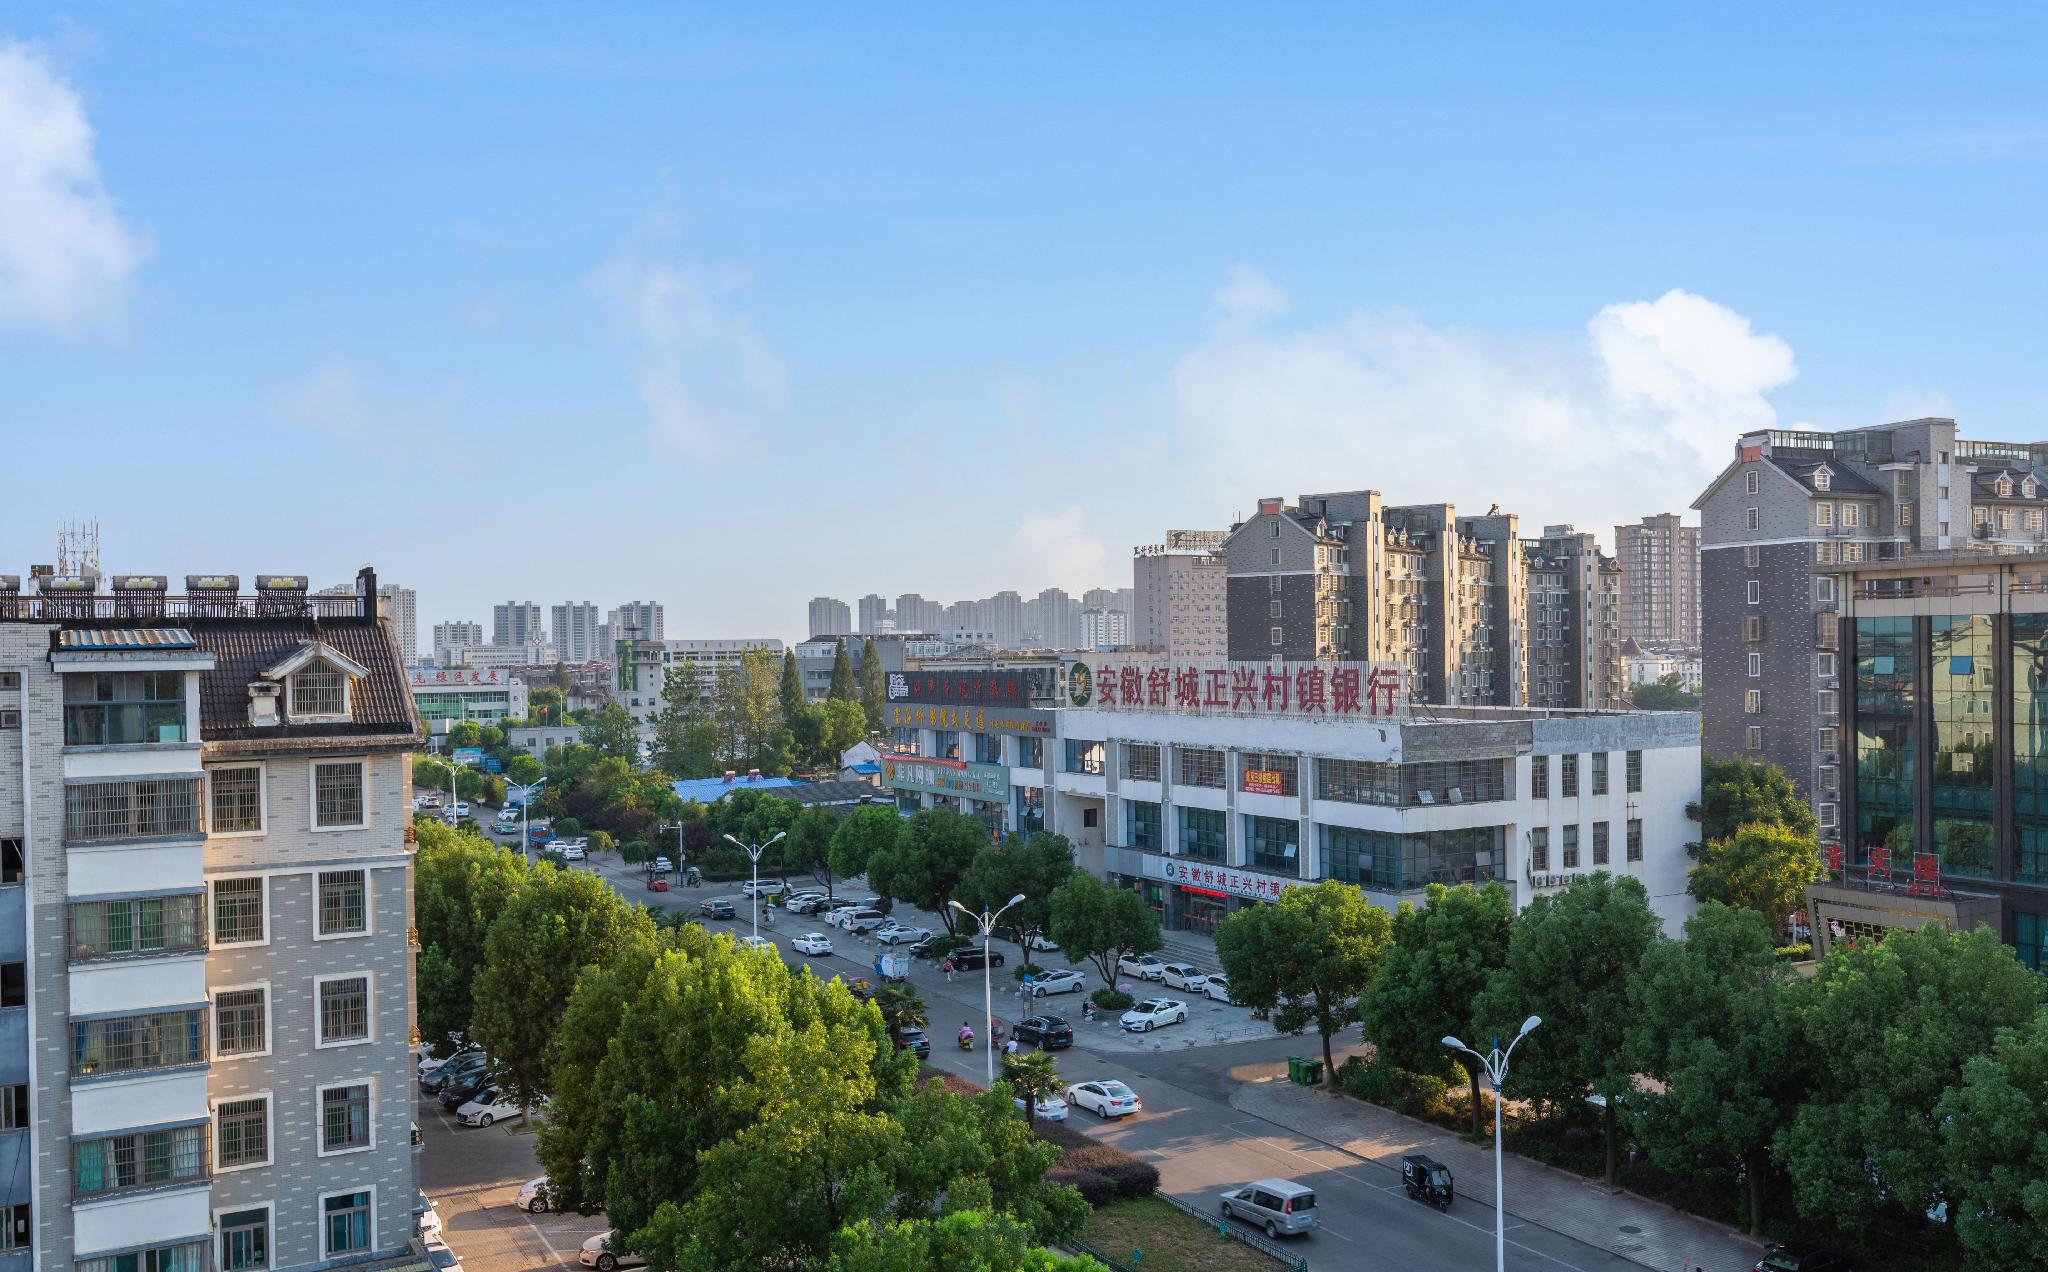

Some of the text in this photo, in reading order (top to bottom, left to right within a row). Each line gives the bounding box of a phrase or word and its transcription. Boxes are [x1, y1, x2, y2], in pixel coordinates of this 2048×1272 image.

[1096, 664, 1401, 716] 安徽舒城正兴村镇银行
[1178, 865, 1288, 896] 安徽舒城正兴村镇
